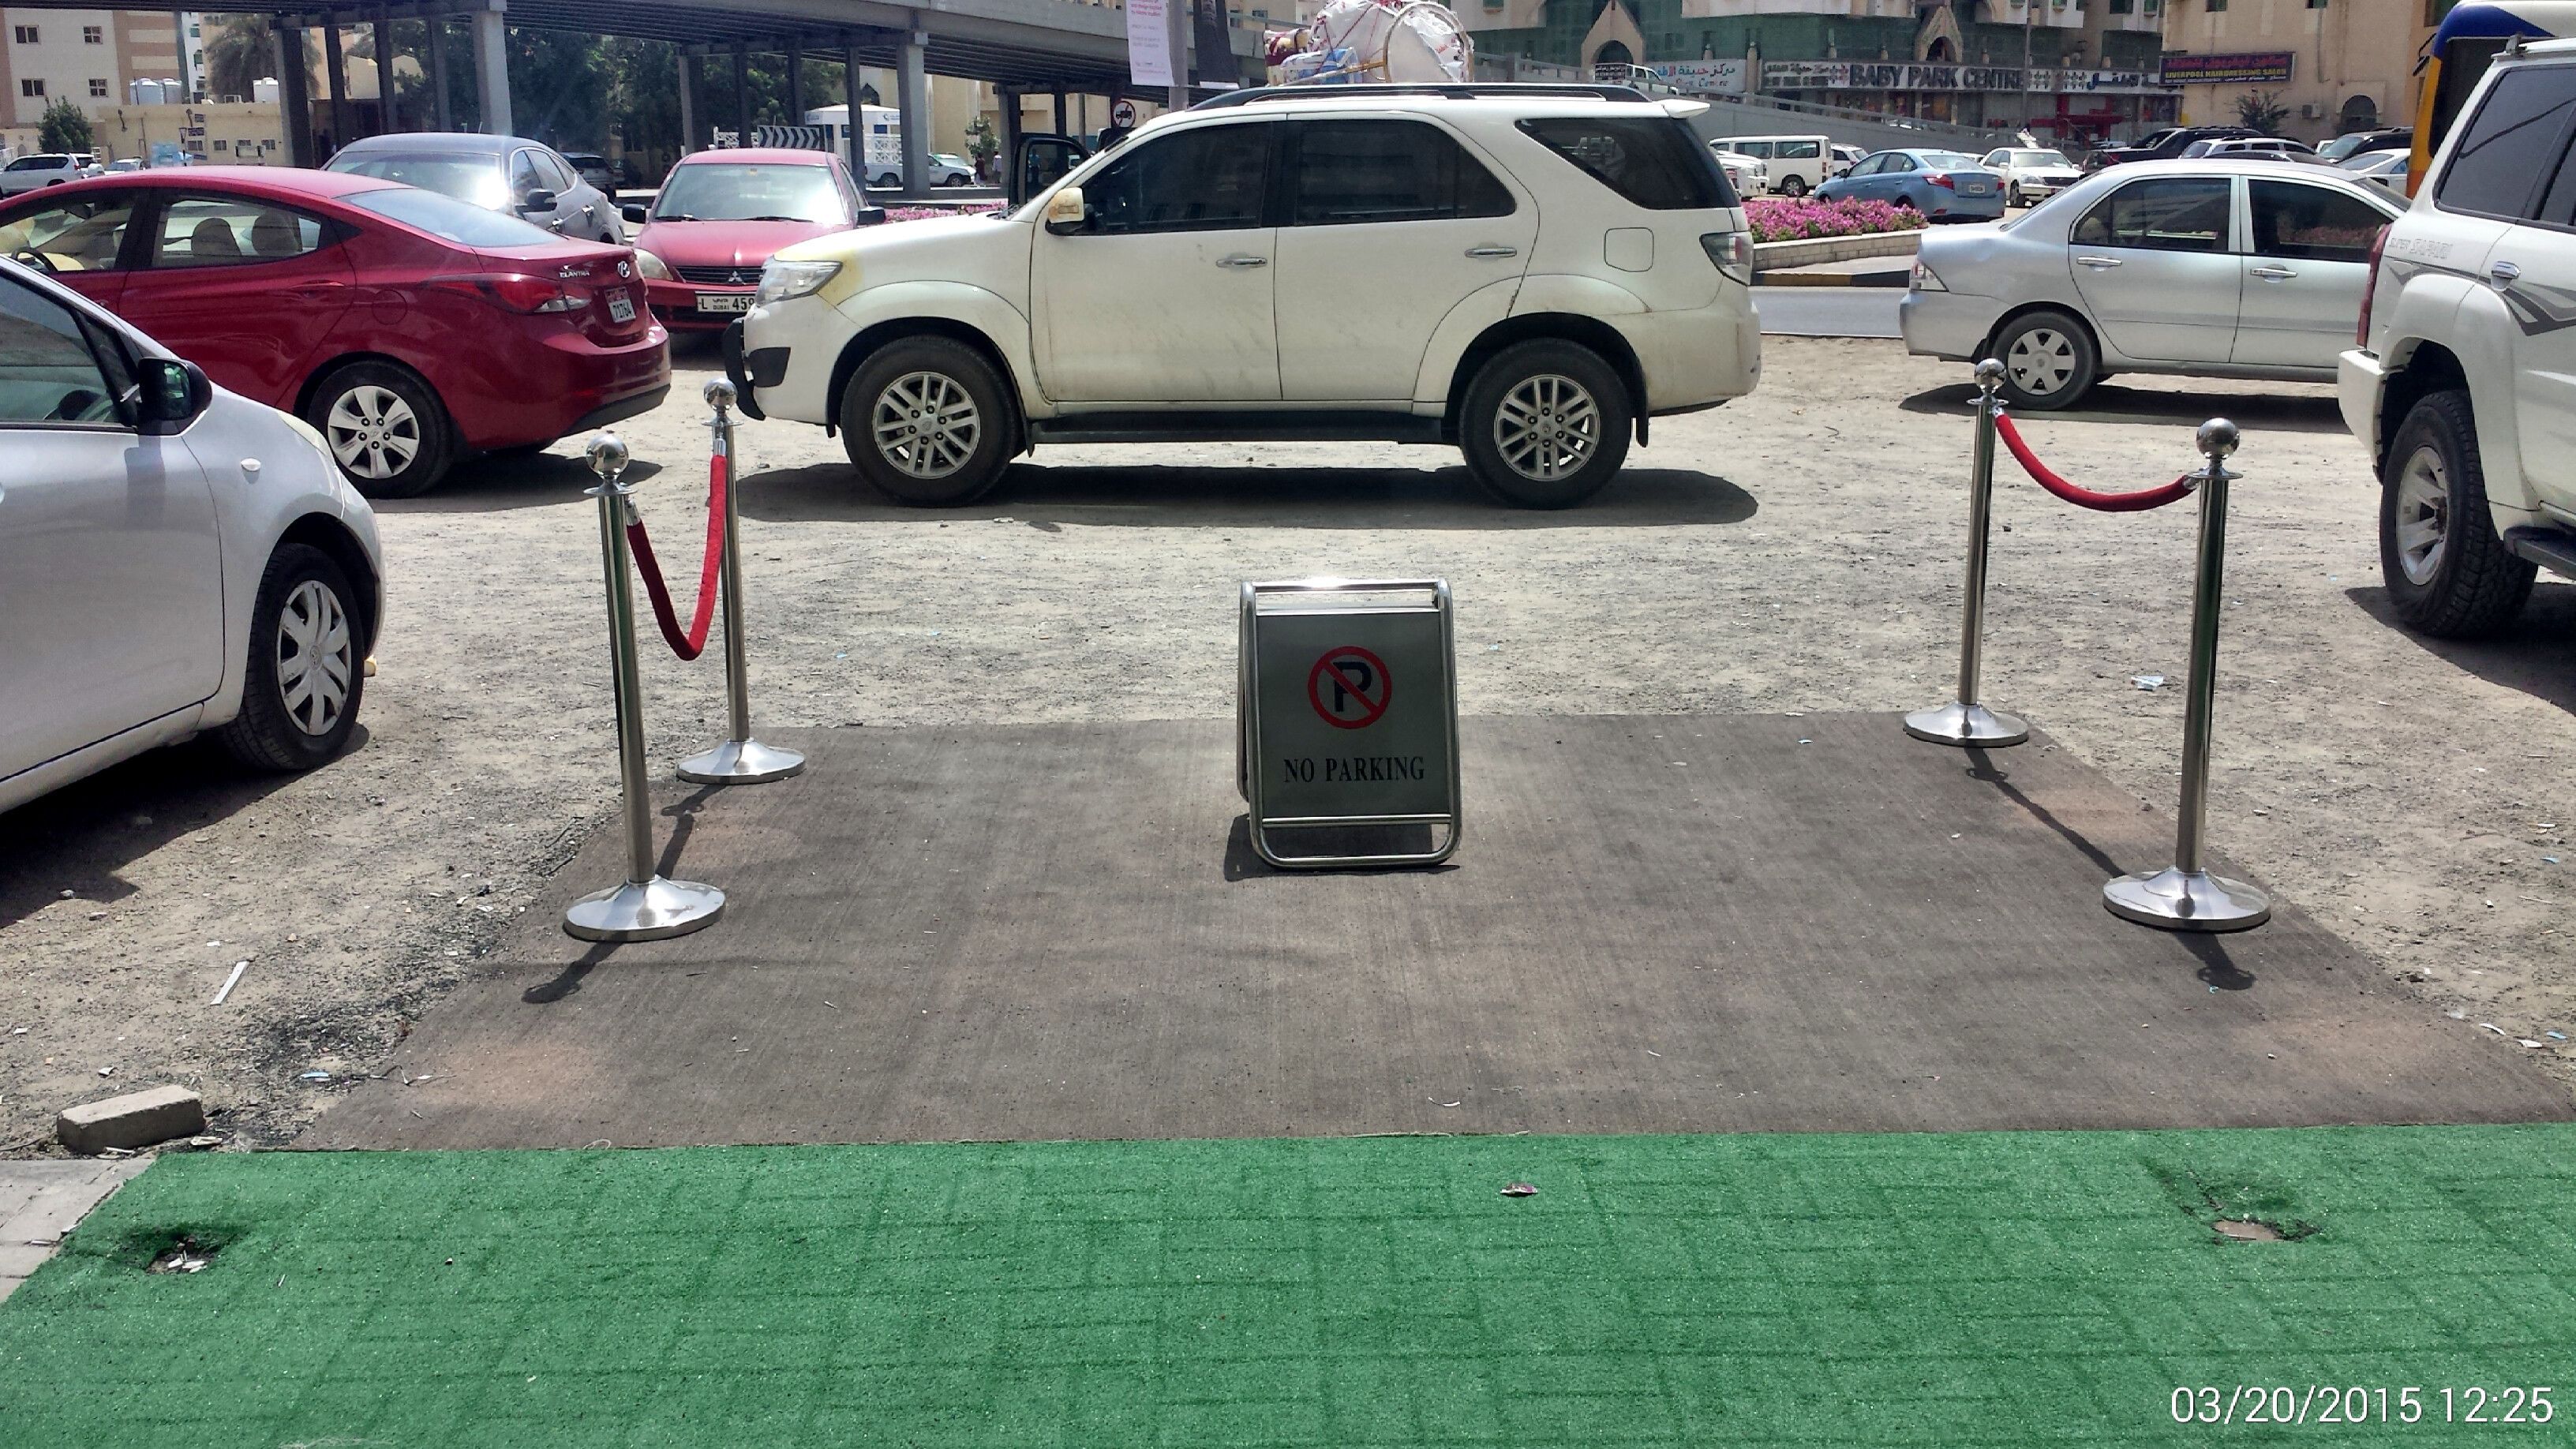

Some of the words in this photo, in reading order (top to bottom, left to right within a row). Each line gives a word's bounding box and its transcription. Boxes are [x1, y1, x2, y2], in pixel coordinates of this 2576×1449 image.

[1850, 65, 1903, 88] BABY
[1908, 66, 1958, 88] PARK
[1284, 758, 1314, 783] NO
[1325, 755, 1425, 782] PARKING
